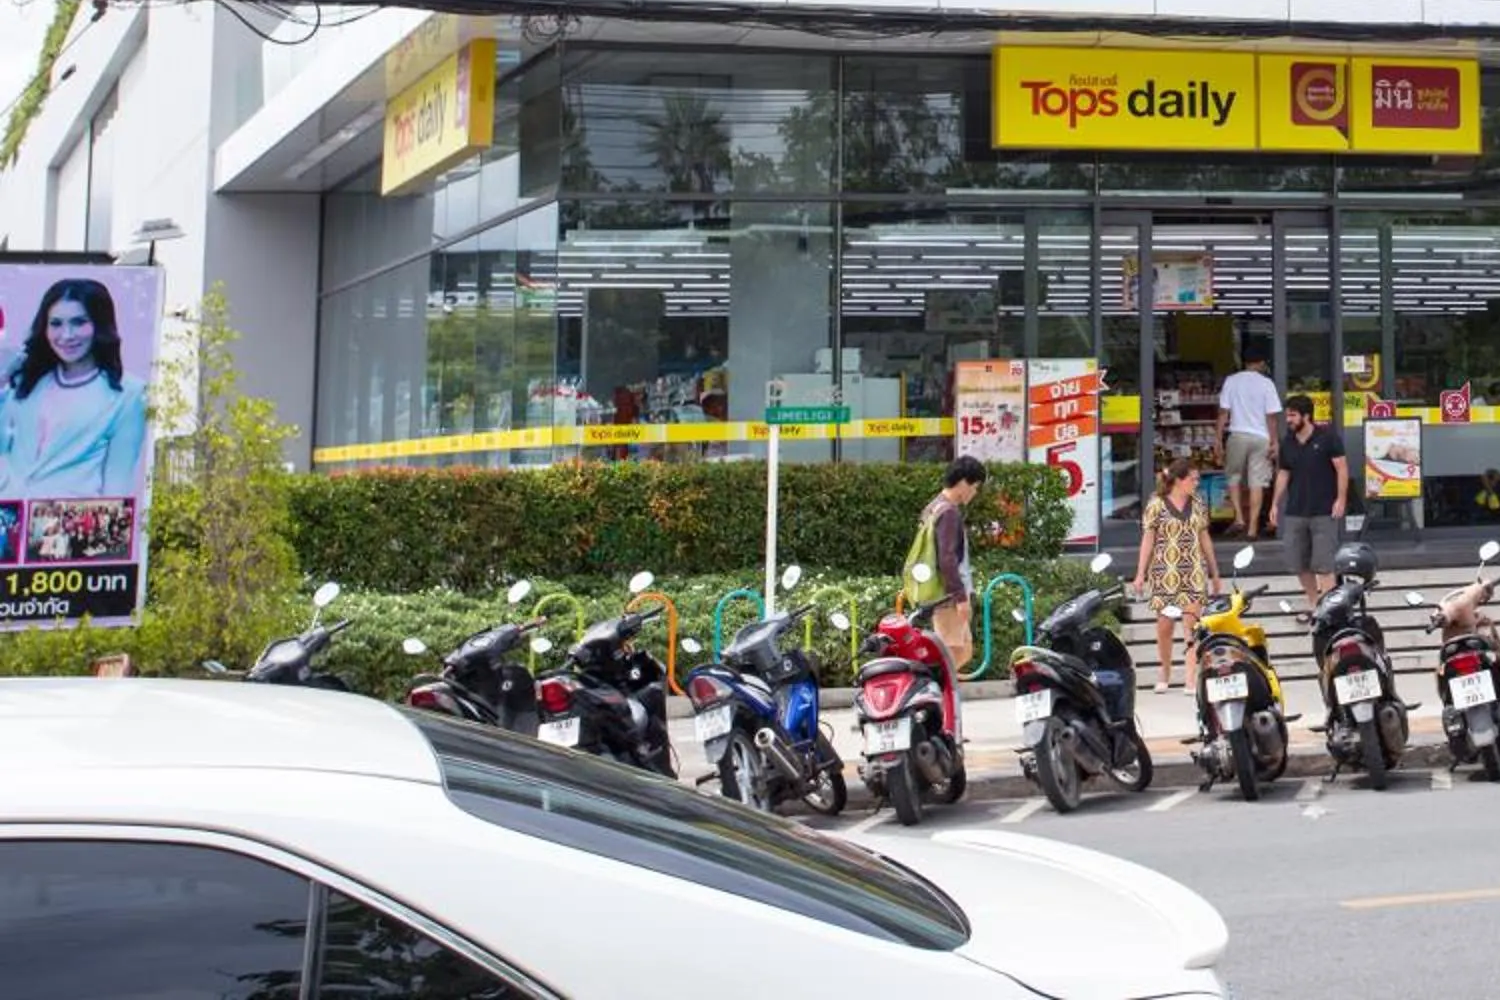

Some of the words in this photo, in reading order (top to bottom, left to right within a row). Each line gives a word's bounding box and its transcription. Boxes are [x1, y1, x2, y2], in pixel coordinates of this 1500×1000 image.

[1020, 80, 1119, 128] Tops
[1127, 80, 1237, 127] daily
[960, 415, 997, 436] 15%
[6, 570, 82, 596] 1,800
[87, 573, 127, 592] บาท
